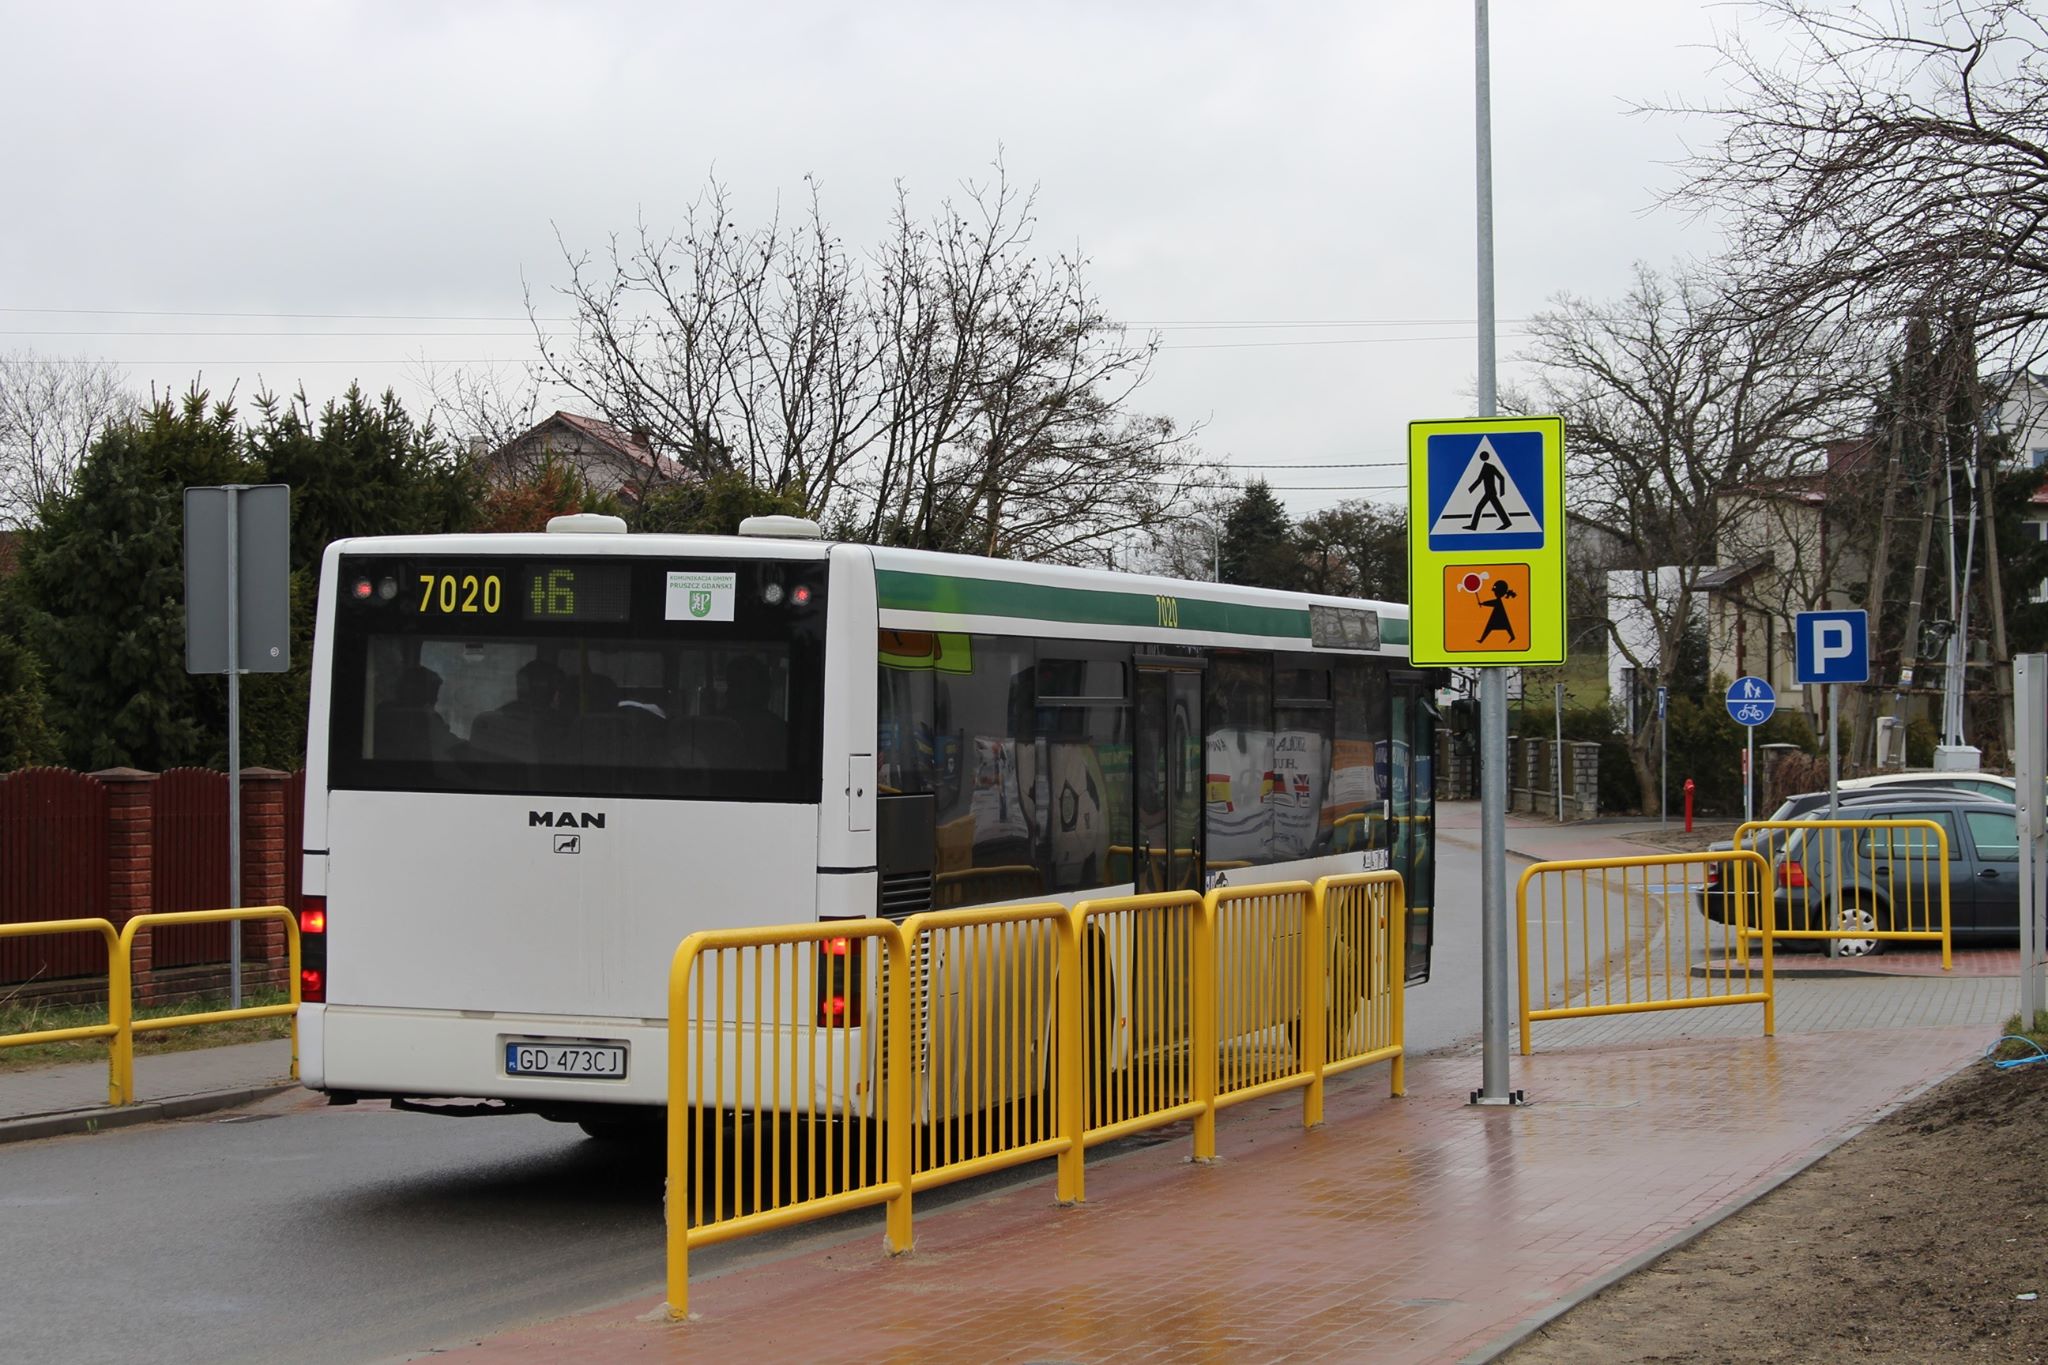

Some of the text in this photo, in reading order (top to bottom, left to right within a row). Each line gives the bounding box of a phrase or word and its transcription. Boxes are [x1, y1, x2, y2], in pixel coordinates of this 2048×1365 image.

[419, 575, 501, 613] 7020
[1156, 596, 1178, 628] 7020
[1813, 620, 1852, 674] P
[528, 811, 606, 829] MAN
[520, 1049, 617, 1073] GD 473CJ
